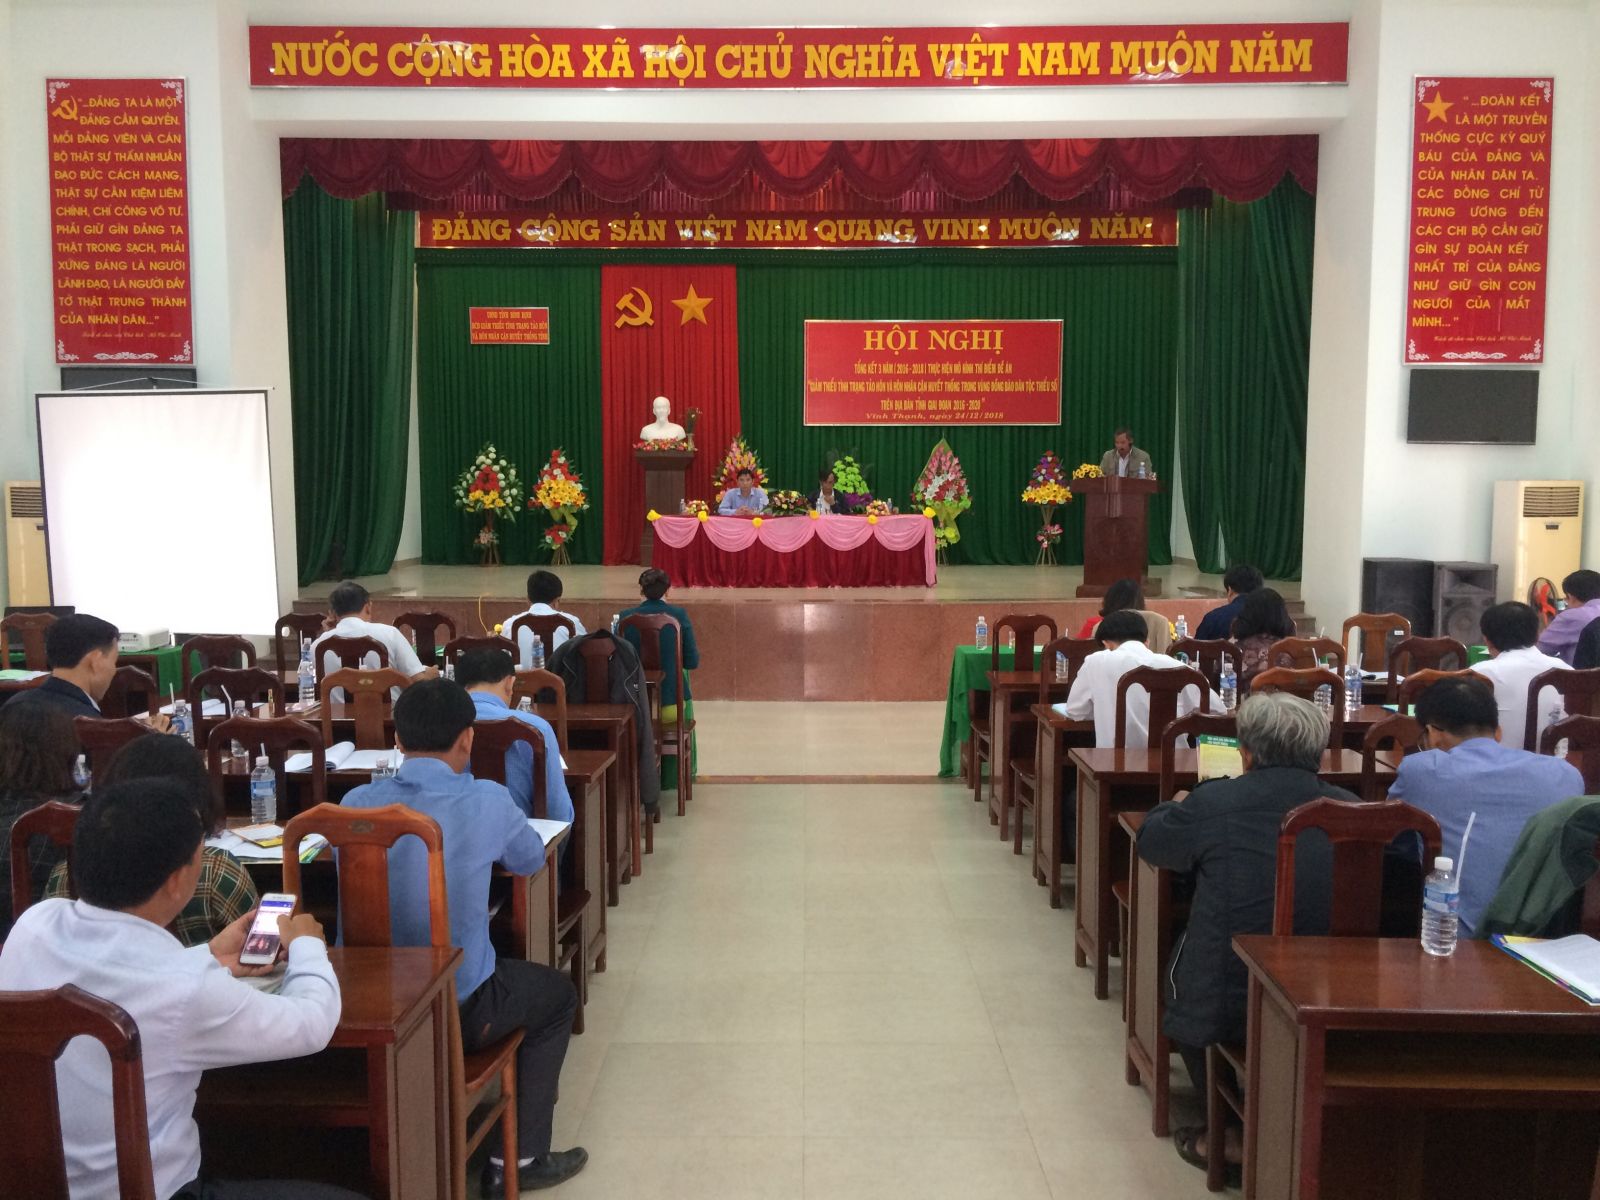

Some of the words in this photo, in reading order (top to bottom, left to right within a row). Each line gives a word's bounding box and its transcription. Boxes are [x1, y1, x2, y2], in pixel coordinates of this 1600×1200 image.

[272, 31, 378, 77] NƯỚC
[387, 33, 492, 84] CỘNG
[500, 34, 572, 78] HÒA
[582, 37, 634, 78] XÃ
[642, 34, 705, 86] HỘI
[715, 31, 792, 78] CHỦ
[804, 36, 920, 78] NGHĨA
[928, 33, 1009, 84] VIỆT
[1018, 42, 1100, 77] NAM
[1110, 30, 1219, 76] MUÔN
[1229, 31, 1313, 72] NĂM
[125, 98, 137, 107] TA
[141, 96, 153, 107] LÀ
[156, 96, 178, 109] MỘT
[1520, 92, 1541, 106] KẾT
[80, 113, 110, 125] ĐẢNG
[114, 112, 138, 125] CẦM
[1456, 112, 1470, 125] LÀ
[1474, 114, 1498, 126] MỘT
[1502, 111, 1547, 125] TRUYỀN
[78, 131, 109, 143] ĐẢNG
[114, 133, 137, 143] VIÊN
[141, 132, 154, 143] VÀ
[1420, 130, 1460, 143] THỐNG
[1467, 132, 1494, 145] CỰC
[1520, 132, 1546, 143] QUÝ
[54, 151, 67, 163] BỘ
[71, 151, 94, 163] THẬT
[98, 151, 111, 163] SỰ
[1452, 148, 1478, 162] CỦA
[1487, 148, 1521, 162] ĐẢNG
[1530, 150, 1545, 162] VÀ
[55, 171, 76, 181] ĐẠO
[80, 167, 103, 179] ĐỨC
[108, 168, 140, 179] CÁCH
[1418, 167, 1444, 180] CỦA
[1451, 169, 1484, 180] NHÂN
[1492, 169, 1516, 180] DÂN
[56, 188, 80, 200] THẬT
[84, 188, 98, 200] SỰ
[131, 187, 156, 200] KIỆM
[160, 188, 183, 198] LIÊM
[1417, 186, 1444, 199] CÁC
[1454, 184, 1489, 198] ĐỒNG
[1500, 187, 1520, 198] CHÍ
[1529, 186, 1544, 198] TỪ
[93, 204, 111, 216] CHÍ
[115, 205, 147, 216] CÔNG
[150, 205, 164, 216] VÔ
[1417, 207, 1455, 217] TRUNG
[1471, 206, 1507, 217] ƯƠNG
[1520, 203, 1543, 217] ĐẾN
[57, 222, 79, 234] PHẢI
[134, 222, 165, 234] ĐẢNG
[170, 226, 183, 234] TA
[432, 212, 511, 241] ĐẢNG
[521, 212, 600, 246] CỘNG
[610, 212, 666, 241] SẢN
[675, 213, 737, 246] VIỆT
[745, 219, 808, 241] NAM
[818, 219, 915, 242] QUANG
[923, 219, 990, 241] VINH
[1000, 212, 1081, 240] MUÔN
[1089, 212, 1153, 239] NĂM
[1416, 224, 1442, 236] CÁC
[1448, 226, 1466, 235] CHI
[1472, 224, 1487, 238] BỘ
[1522, 224, 1543, 235] GIỮ
[57, 242, 82, 254] THẬT
[86, 244, 121, 252] TRONG
[161, 240, 184, 252] PHẢI
[1415, 242, 1436, 254] GÌN
[1444, 243, 1460, 256] SỰ
[1468, 242, 1502, 254] ĐOÀN
[1508, 241, 1528, 254] KẾT
[95, 259, 127, 270] ĐÁNG
[132, 259, 145, 270] LÀ
[1453, 260, 1469, 272] TRÍ
[1477, 259, 1502, 272] CỦA
[1508, 259, 1541, 272] ĐẢNG
[114, 278, 126, 288] LÀ
[1414, 280, 1439, 290] NHƯ
[1449, 278, 1472, 291] GIỮ
[1480, 279, 1500, 290] GÌN
[1509, 281, 1536, 290] CON
[59, 294, 73, 306] TỚ
[78, 296, 102, 308] THẬT
[109, 297, 144, 306] TRUNG
[152, 296, 186, 306] THÀNH
[1466, 296, 1490, 309] CỦA
[1506, 295, 1530, 309] MẮT
[60, 312, 83, 324] CỦA
[88, 314, 118, 324] NHÂN
[864, 324, 918, 356] HỘI
[928, 330, 1004, 354] NGHỊ
